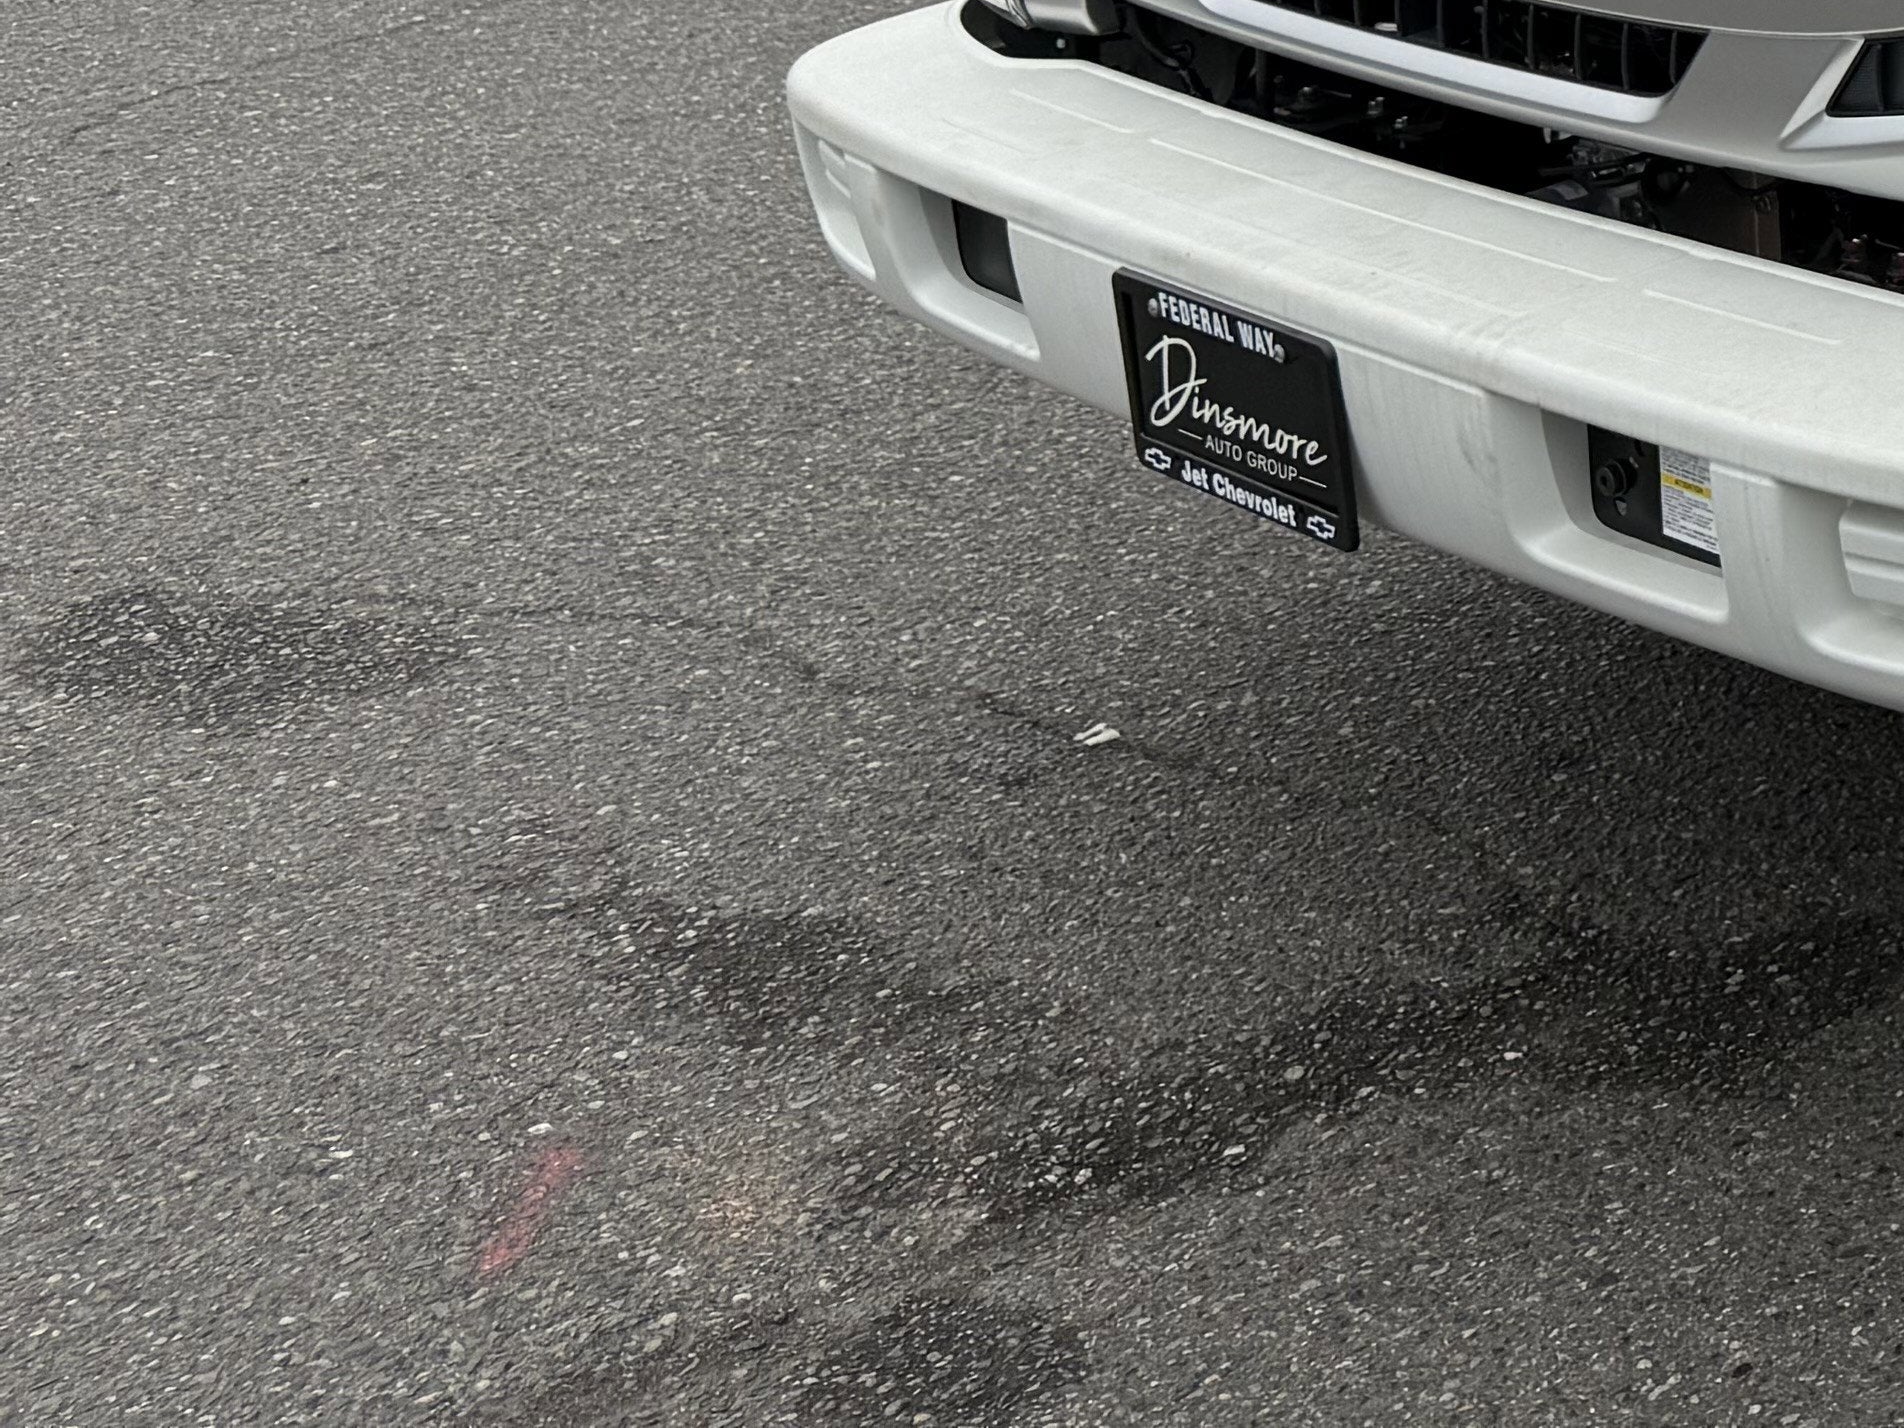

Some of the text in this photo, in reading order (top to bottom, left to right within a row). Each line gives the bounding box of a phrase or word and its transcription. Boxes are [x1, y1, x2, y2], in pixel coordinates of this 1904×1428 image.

[1158, 292, 1276, 358] FEDERAL WAY
[1145, 334, 1328, 466] Dinsmore
[1205, 434, 1298, 482] AUTO GROUP
[1181, 460, 1297, 527] Jet Chevrolet
